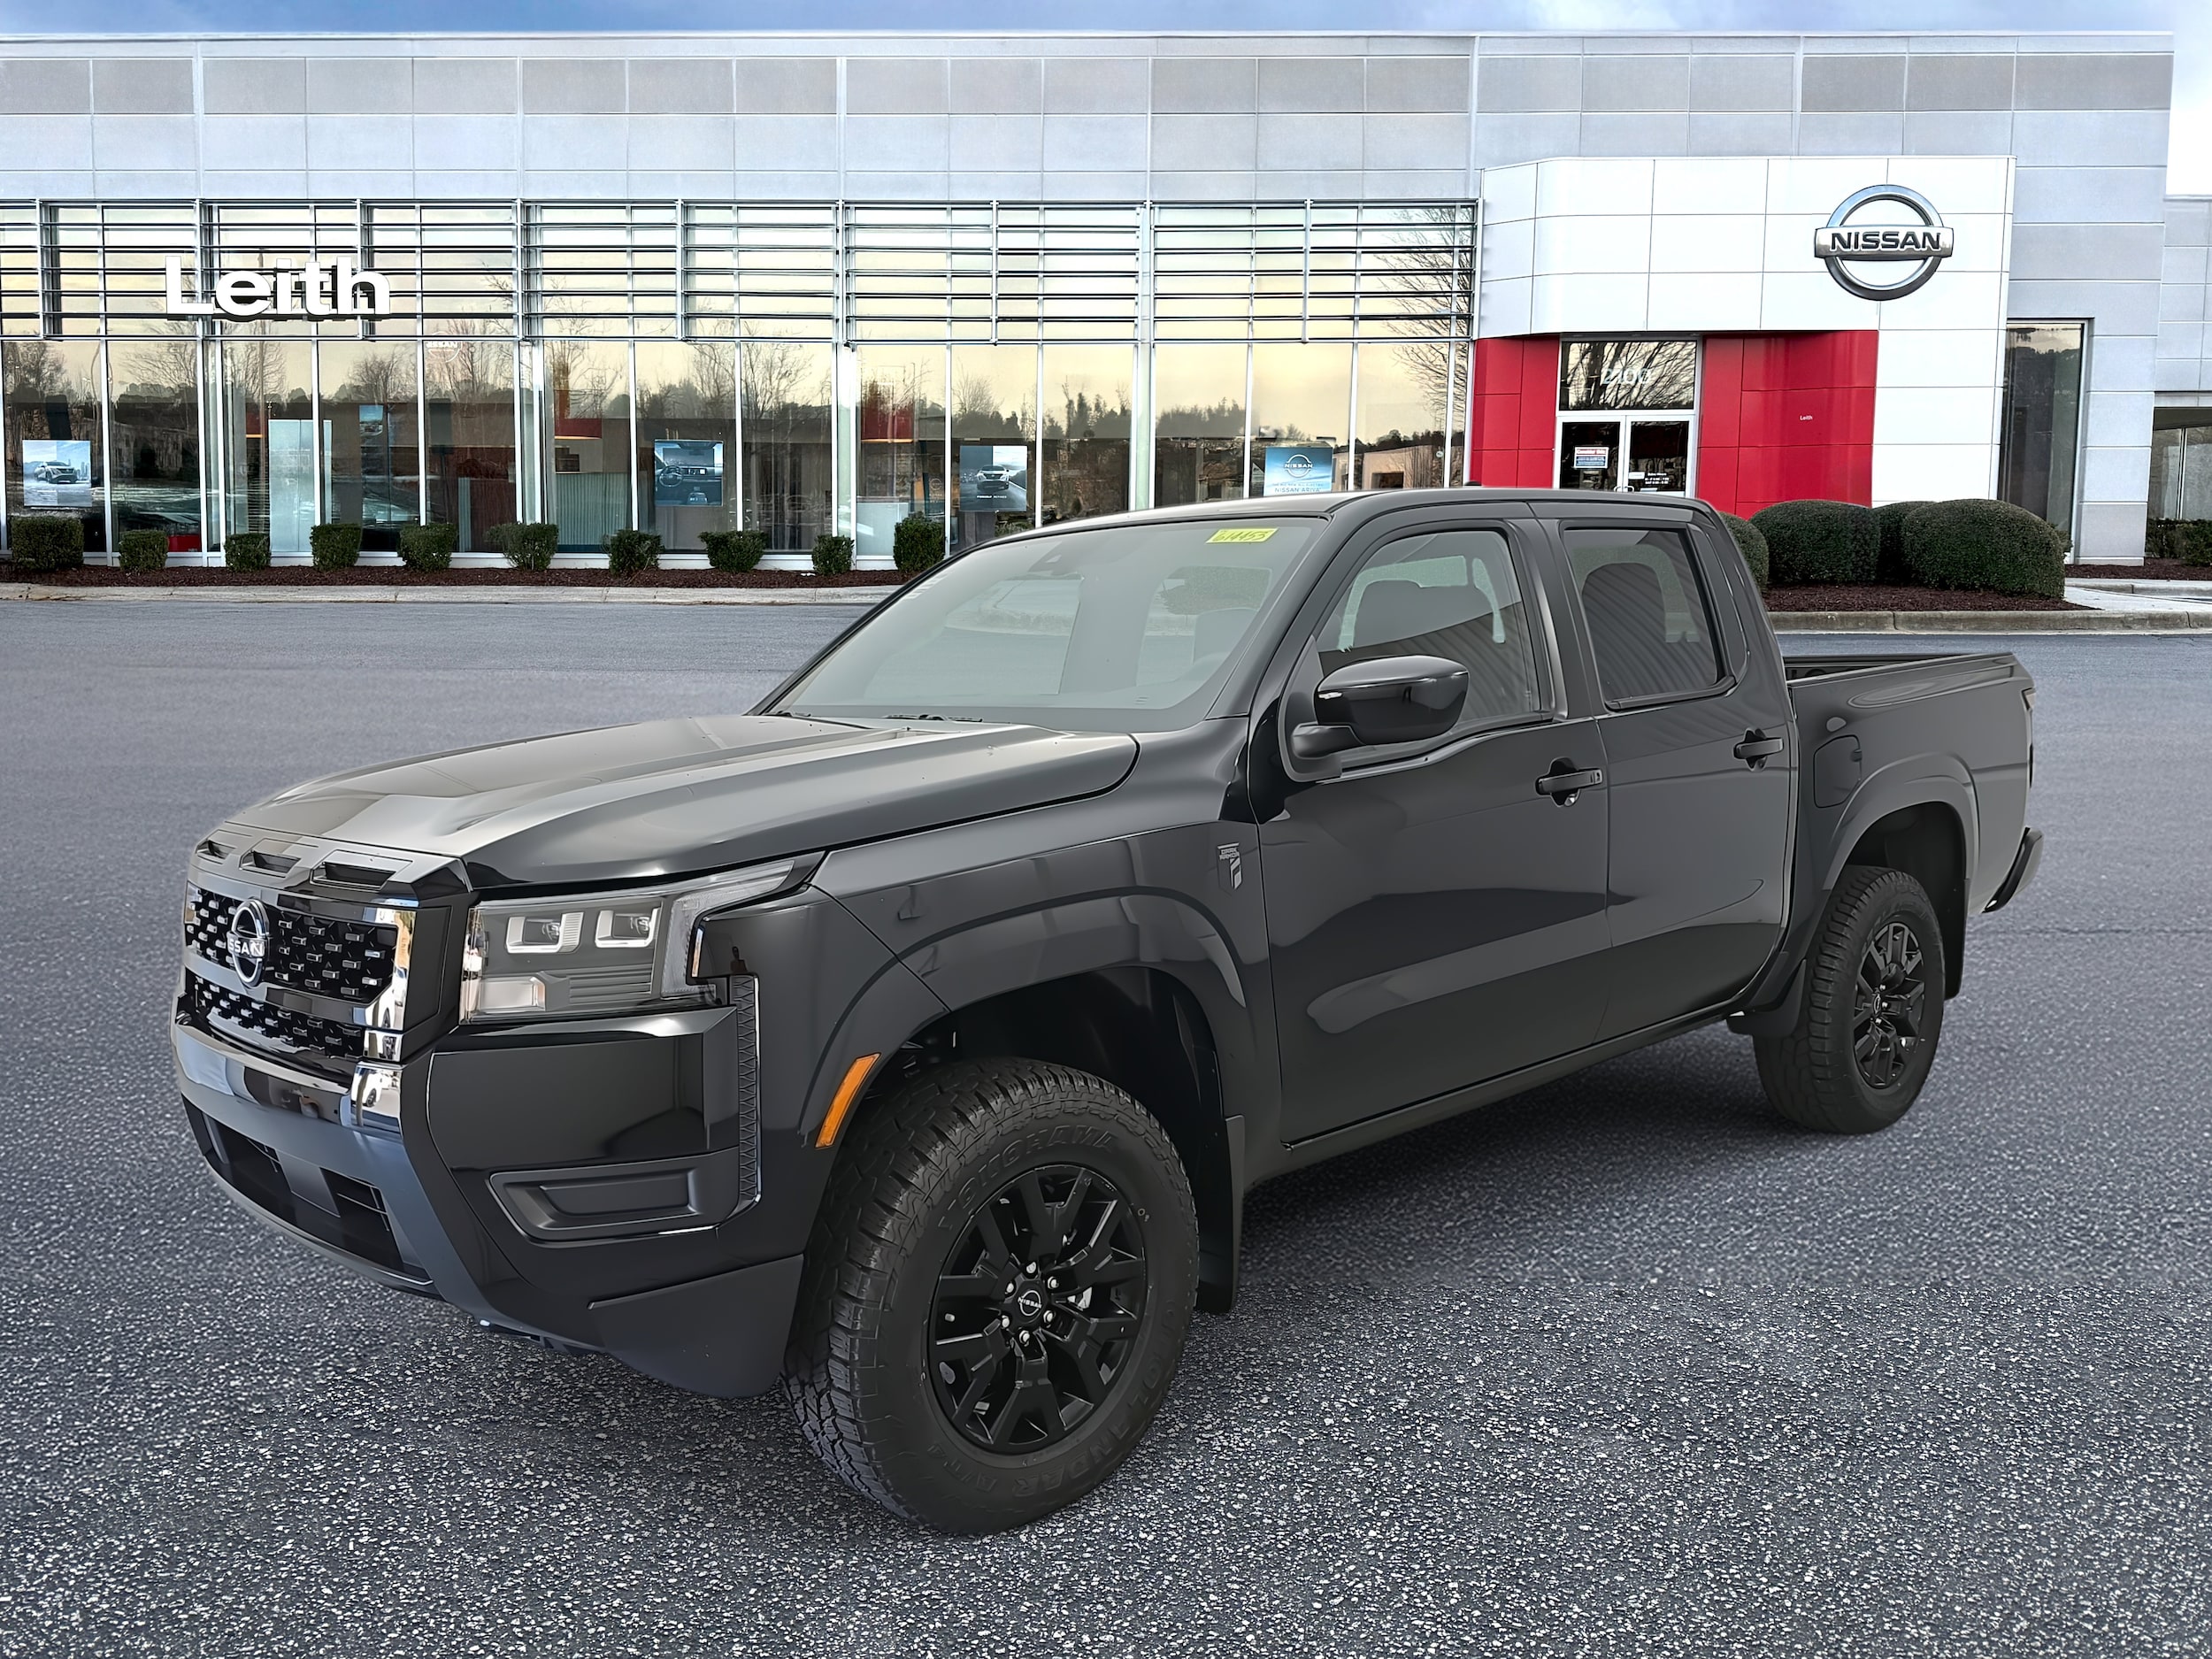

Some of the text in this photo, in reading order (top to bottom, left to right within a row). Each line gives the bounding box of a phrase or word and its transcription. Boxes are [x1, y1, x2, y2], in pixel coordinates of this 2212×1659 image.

[1831, 231, 1941, 250] NISSAN
[165, 256, 391, 317] Leith
[227, 938, 264, 957] SSAN
[1017, 1296, 1042, 1309] NISSAN
